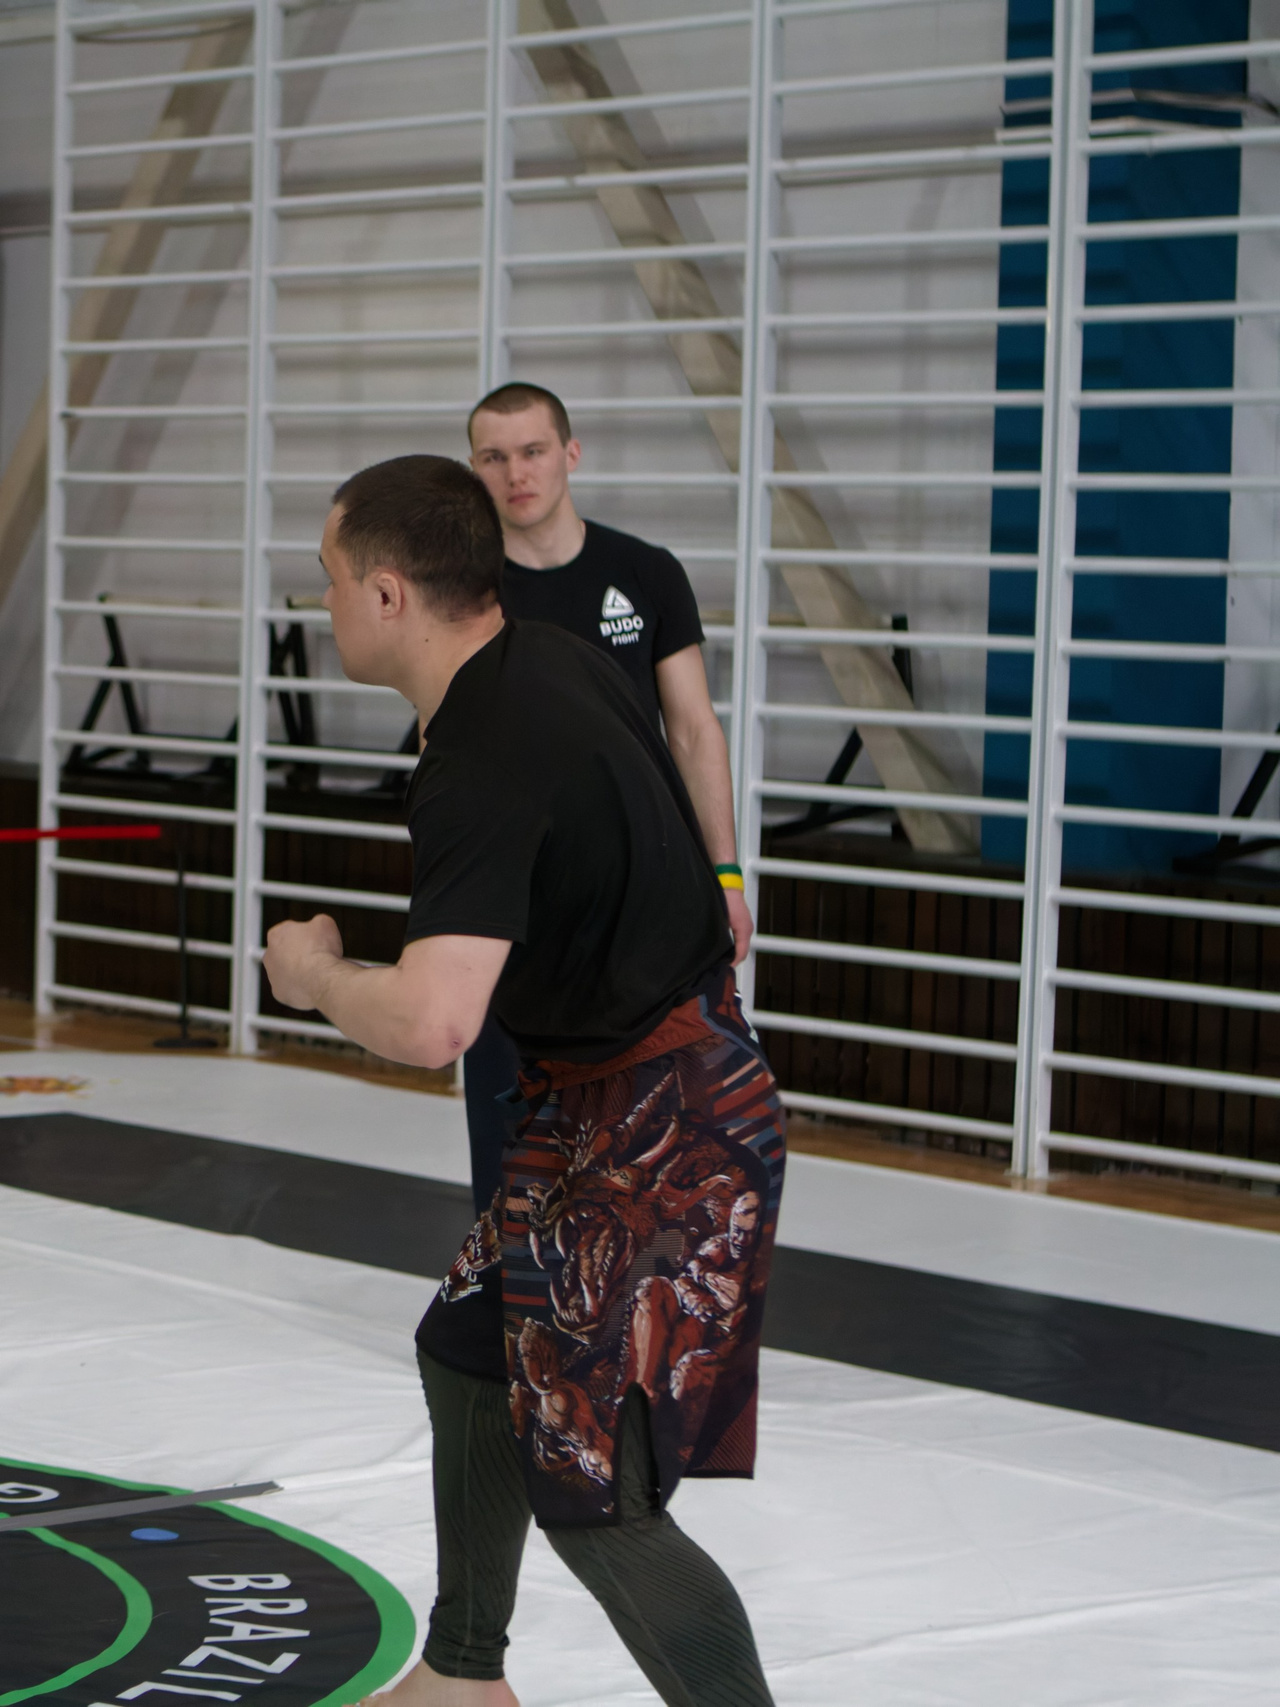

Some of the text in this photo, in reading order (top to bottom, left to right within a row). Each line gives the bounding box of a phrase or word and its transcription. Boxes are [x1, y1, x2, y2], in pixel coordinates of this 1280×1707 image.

[599, 614, 644, 637] BUDO
[611, 631, 639, 646] FIGHT
[86, 1573, 311, 1707] BRAZIL
